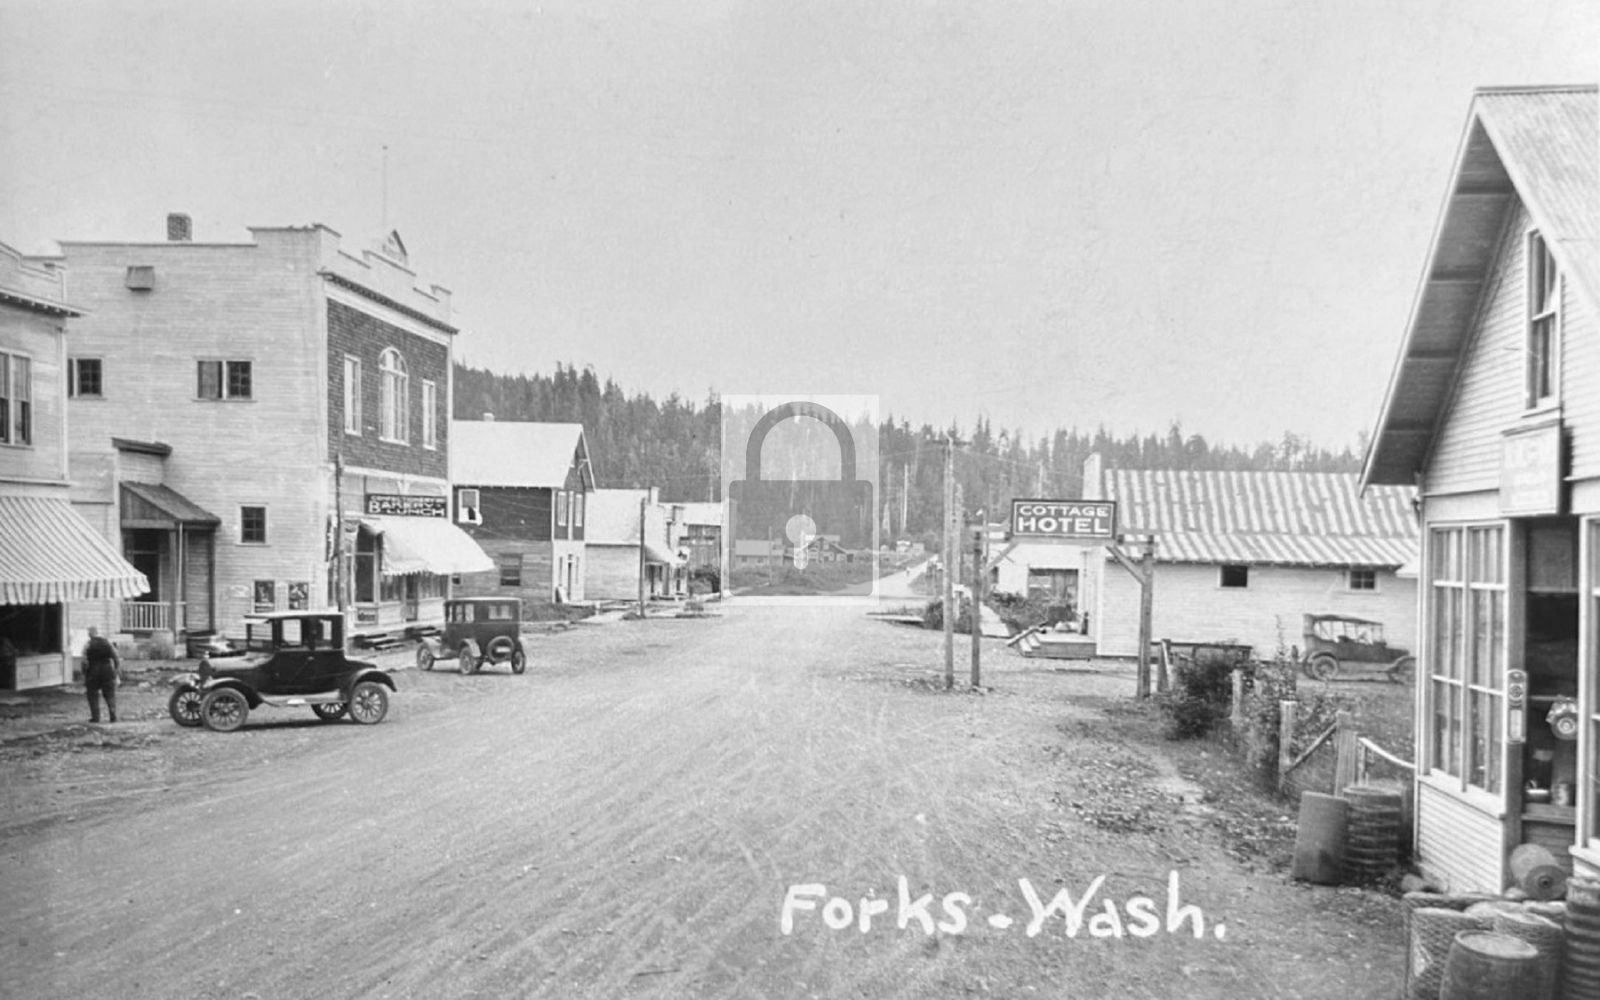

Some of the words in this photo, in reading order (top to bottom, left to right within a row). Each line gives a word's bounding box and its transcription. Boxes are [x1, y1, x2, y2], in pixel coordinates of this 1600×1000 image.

[387, 508, 445, 516] LUNCH
[1019, 505, 1109, 517] COTTAGE
[1018, 517, 1109, 533] HOTEL
